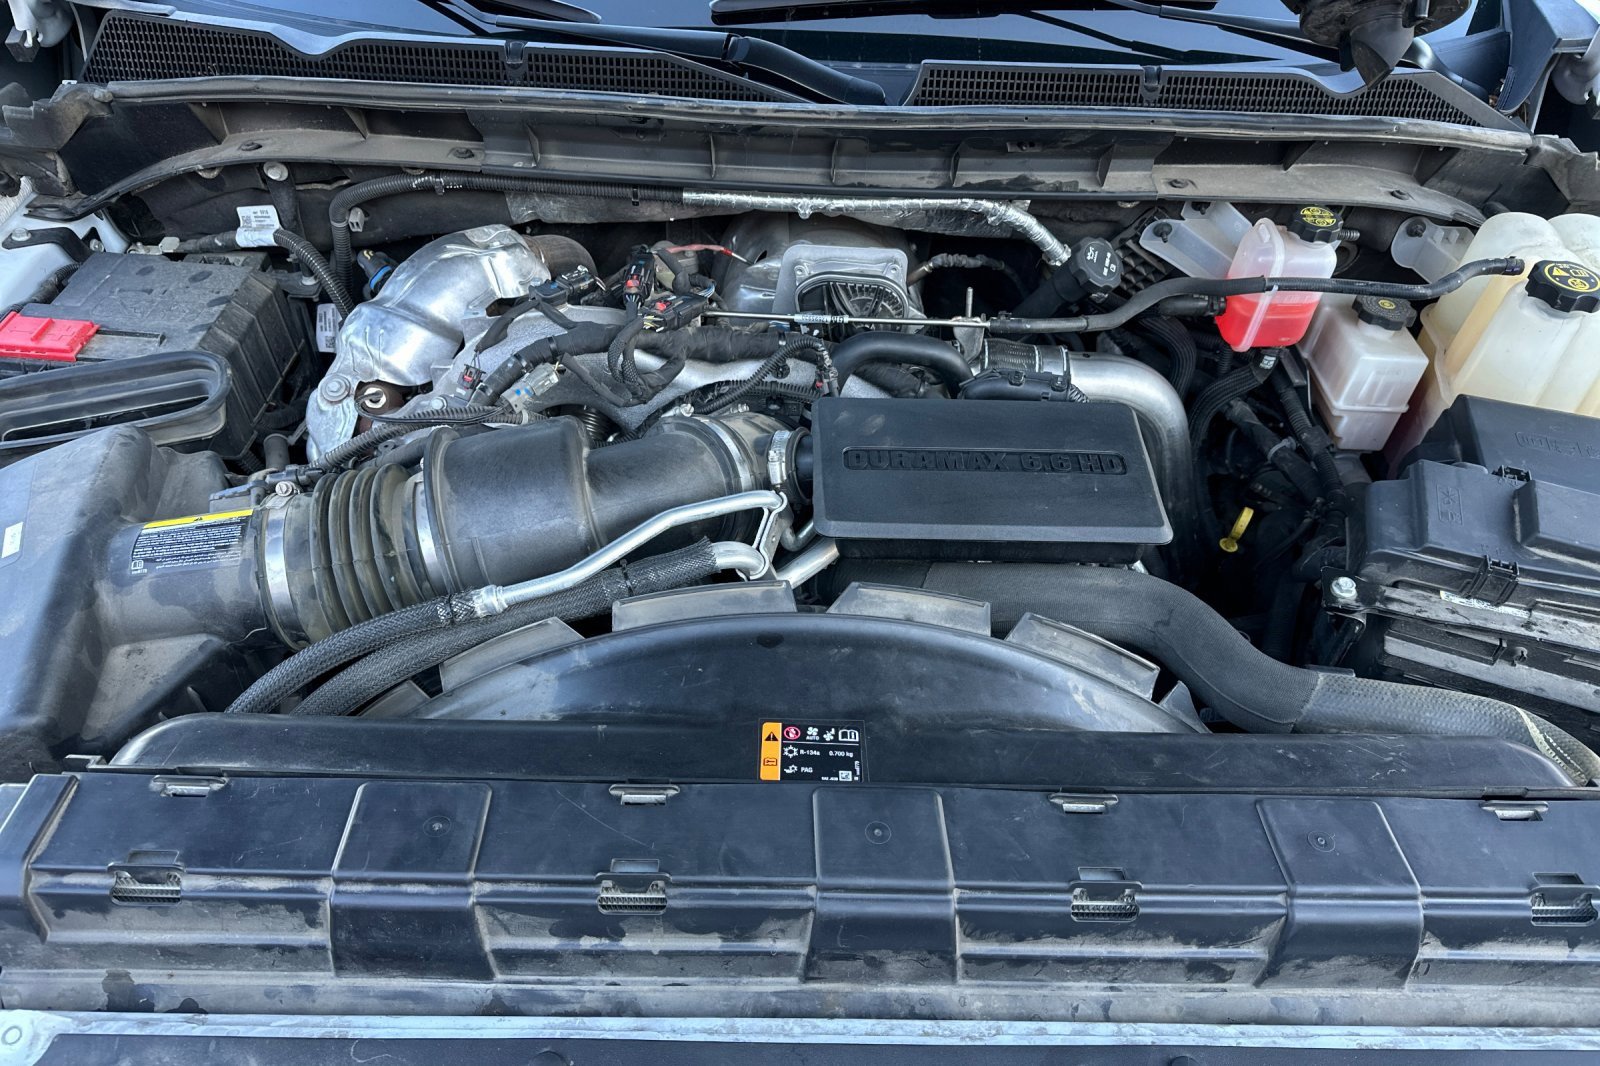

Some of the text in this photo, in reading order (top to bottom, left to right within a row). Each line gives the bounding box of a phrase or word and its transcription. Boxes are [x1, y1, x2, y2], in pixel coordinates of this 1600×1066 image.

[847, 450, 1126, 474] DURAMAX 6.6 HD
